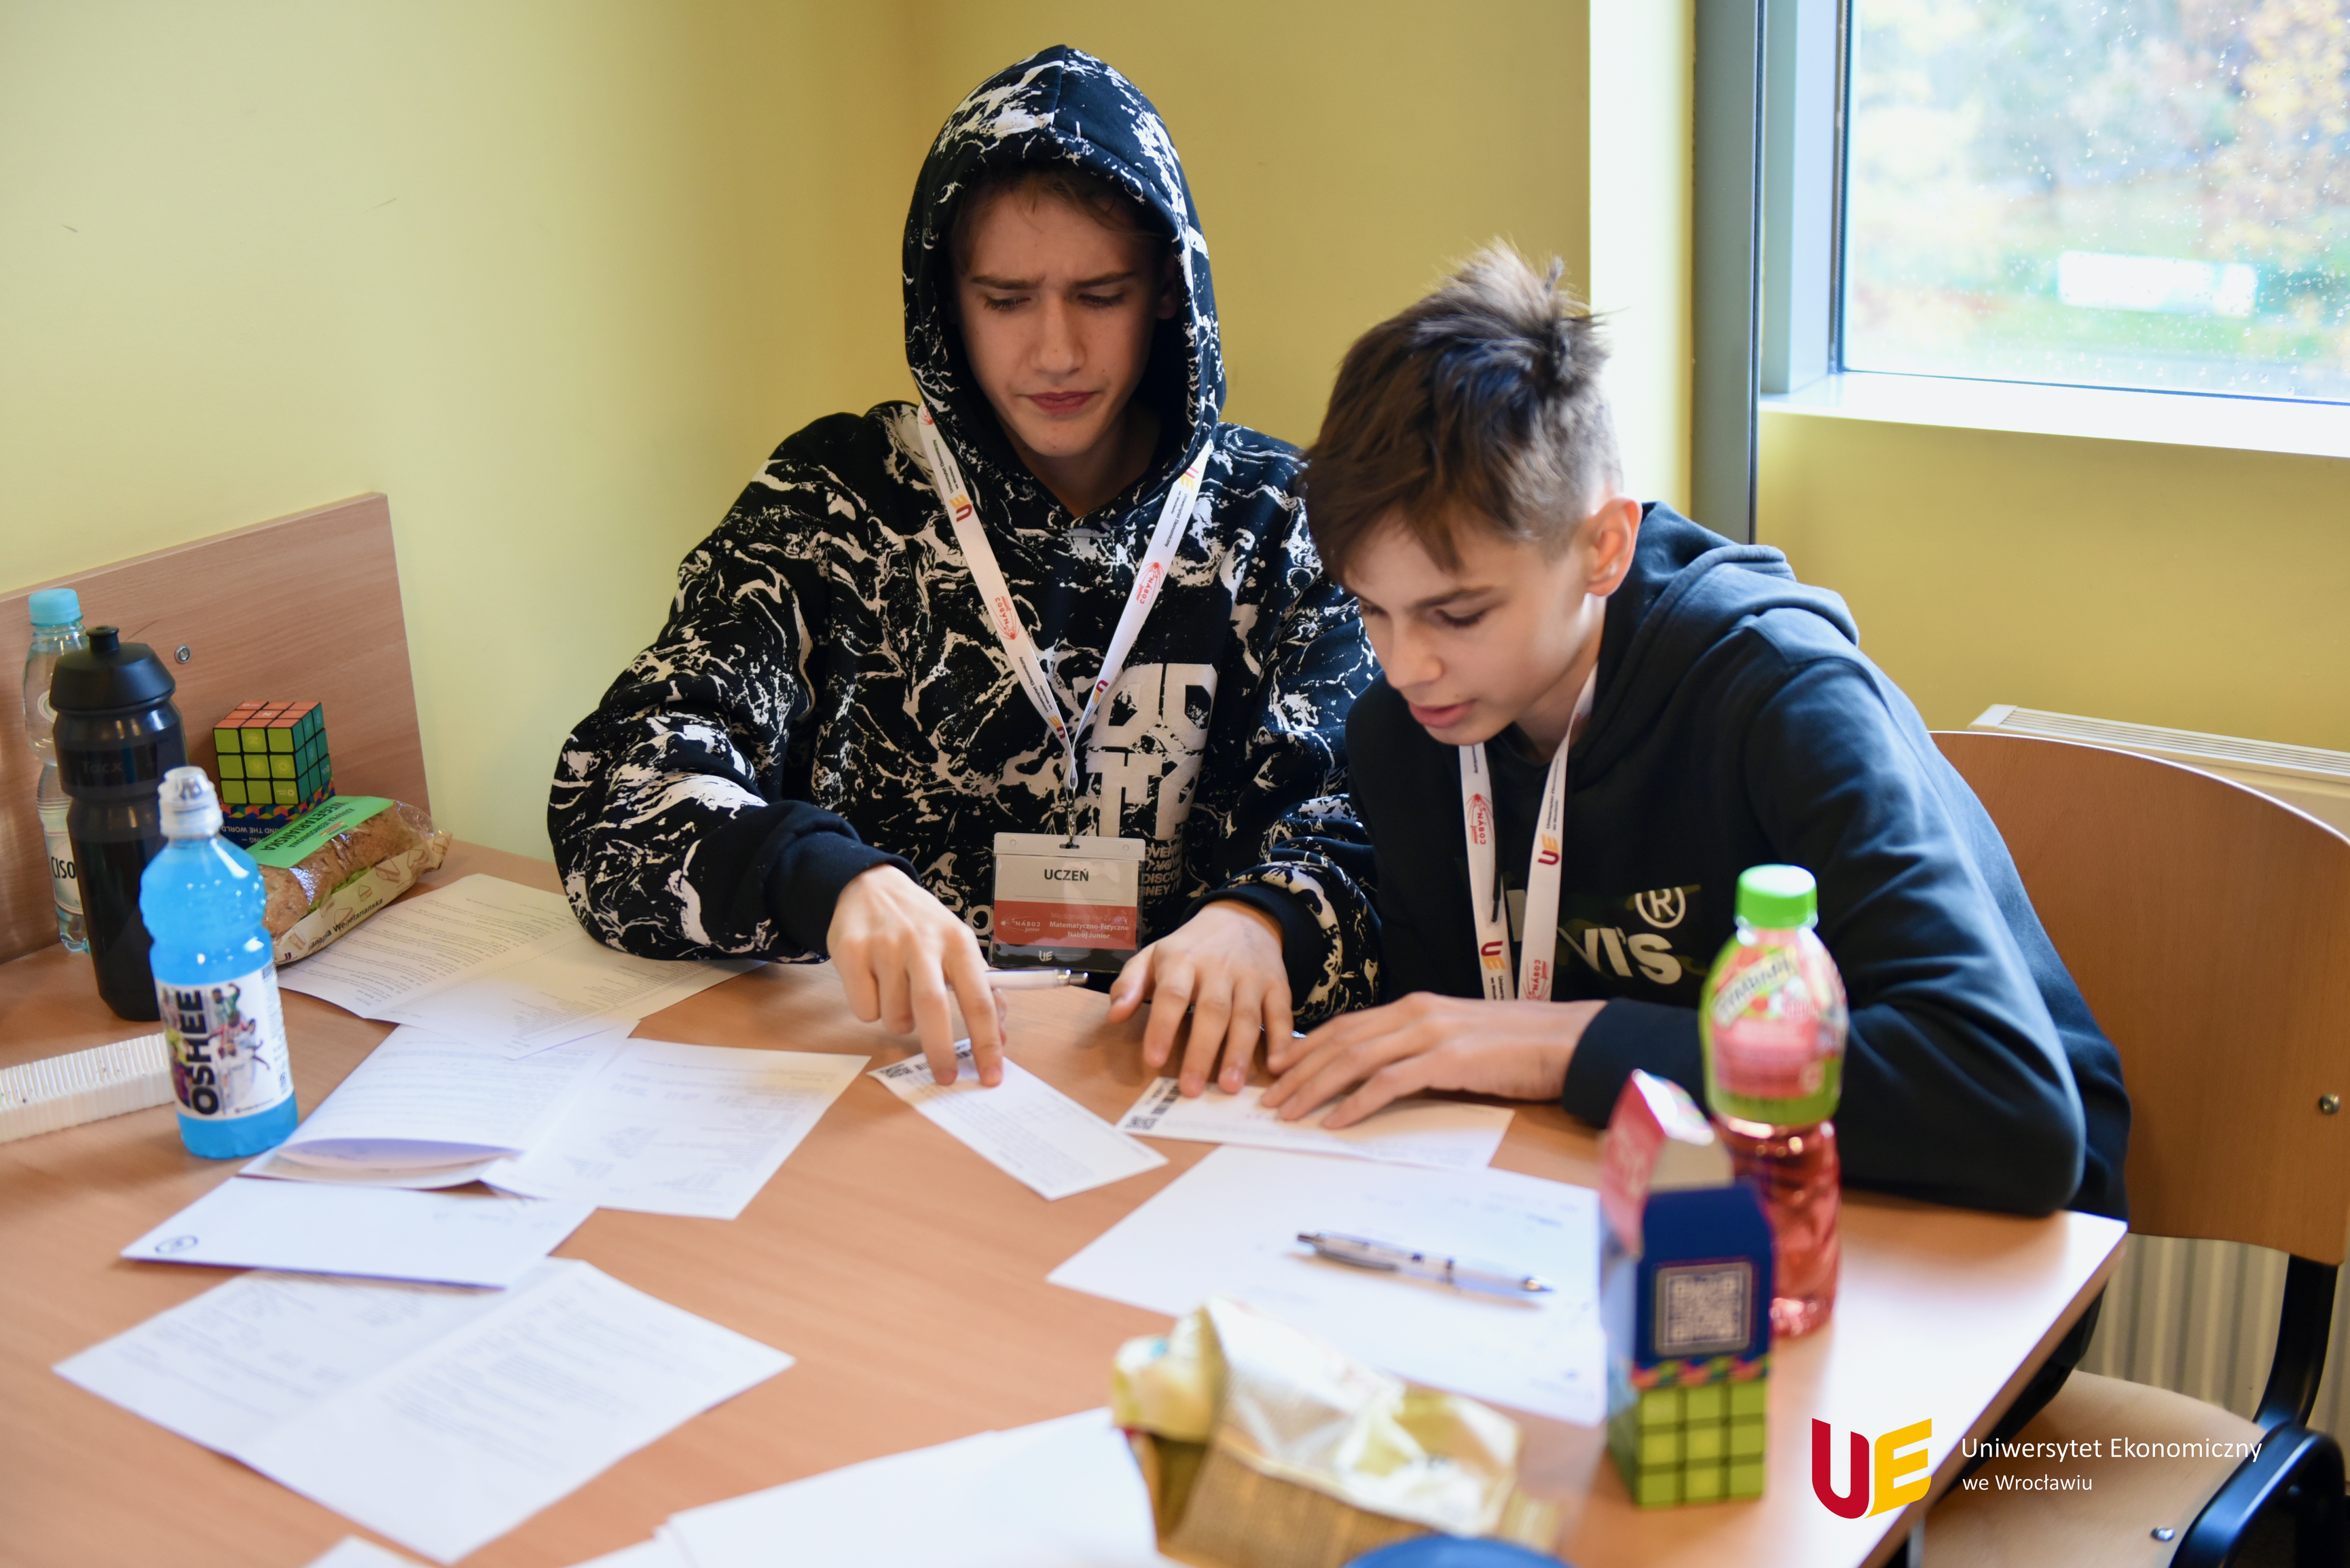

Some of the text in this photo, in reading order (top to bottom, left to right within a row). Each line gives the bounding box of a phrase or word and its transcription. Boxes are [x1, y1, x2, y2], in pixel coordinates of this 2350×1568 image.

[949, 493, 972, 523] UE
[1135, 584, 1145, 601] junior
[1139, 576, 1154, 604] NÁBOJ
[995, 597, 1009, 624] NÁBOJ
[1001, 596, 1012, 611] junior
[1093, 679, 1109, 705] UE
[1048, 715, 1066, 739] UE
[81, 760, 124, 774] Tacx
[221, 826, 247, 834] WORLD
[1470, 825, 1479, 844] junior
[1477, 812, 1486, 844] NÁBOJ
[1538, 834, 1560, 865] UE
[1044, 868, 1089, 882] UCZEŃ
[1050, 921, 1129, 931] Matematyczno-Fizyczne
[1067, 931, 1088, 939] Náboj
[1039, 950, 1052, 962] UE
[1481, 940, 1506, 971] UE
[176, 990, 219, 1115] OSHEE
